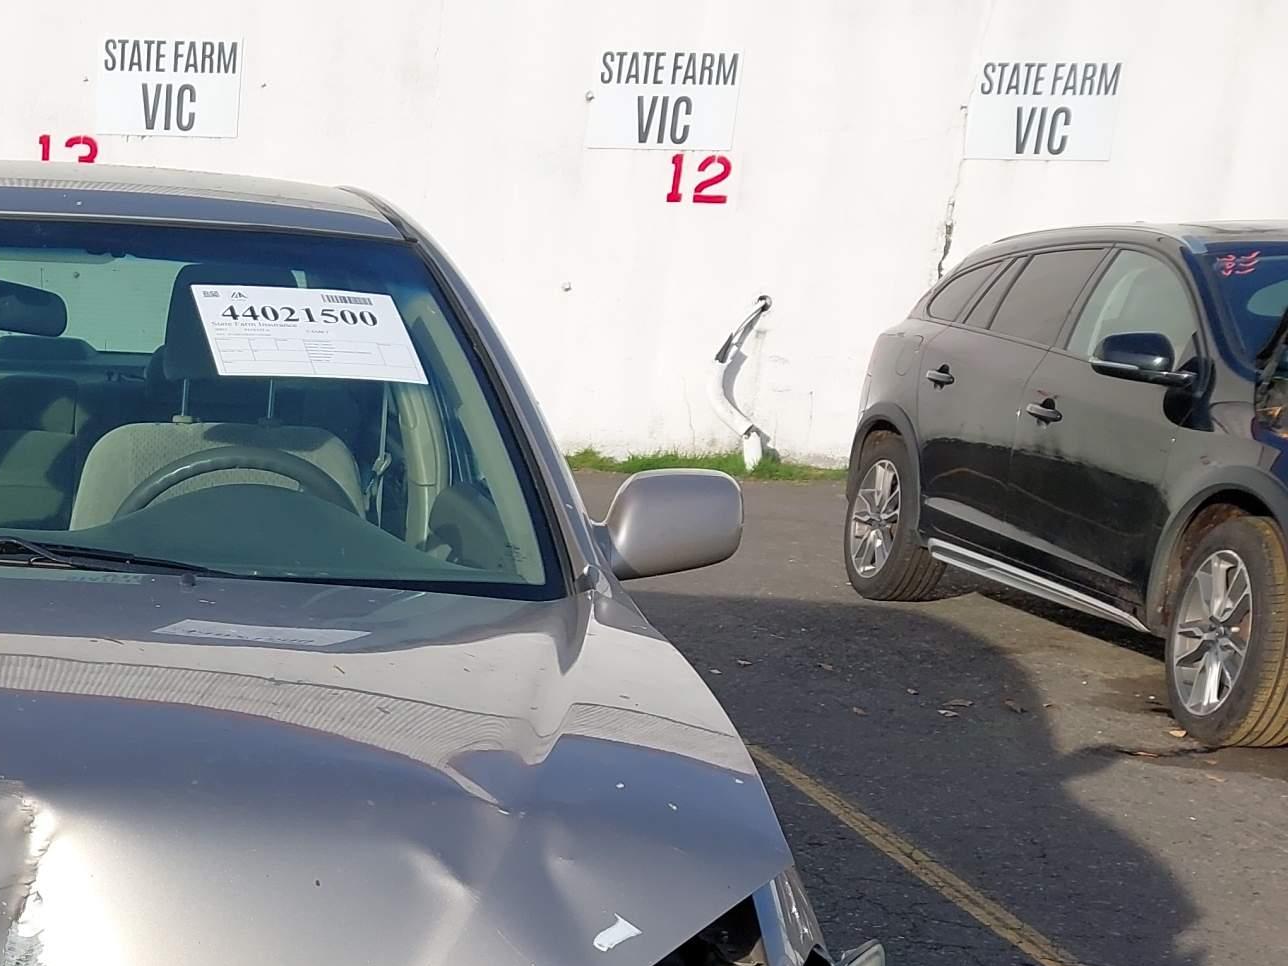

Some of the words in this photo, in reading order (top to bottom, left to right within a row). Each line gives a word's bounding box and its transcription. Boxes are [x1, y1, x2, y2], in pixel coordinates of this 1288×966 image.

[104, 39, 167, 73] STATE
[173, 40, 238, 74] FARM
[600, 51, 667, 85] STATE
[670, 52, 739, 86] FARM
[980, 62, 1047, 96] STATE
[1050, 62, 1122, 96] FARM
[141, 83, 197, 132] VIC
[637, 95, 693, 145] VIC
[1015, 106, 1071, 156] VIC
[666, 153, 732, 204] 12
[222, 304, 378, 327] 44021500
